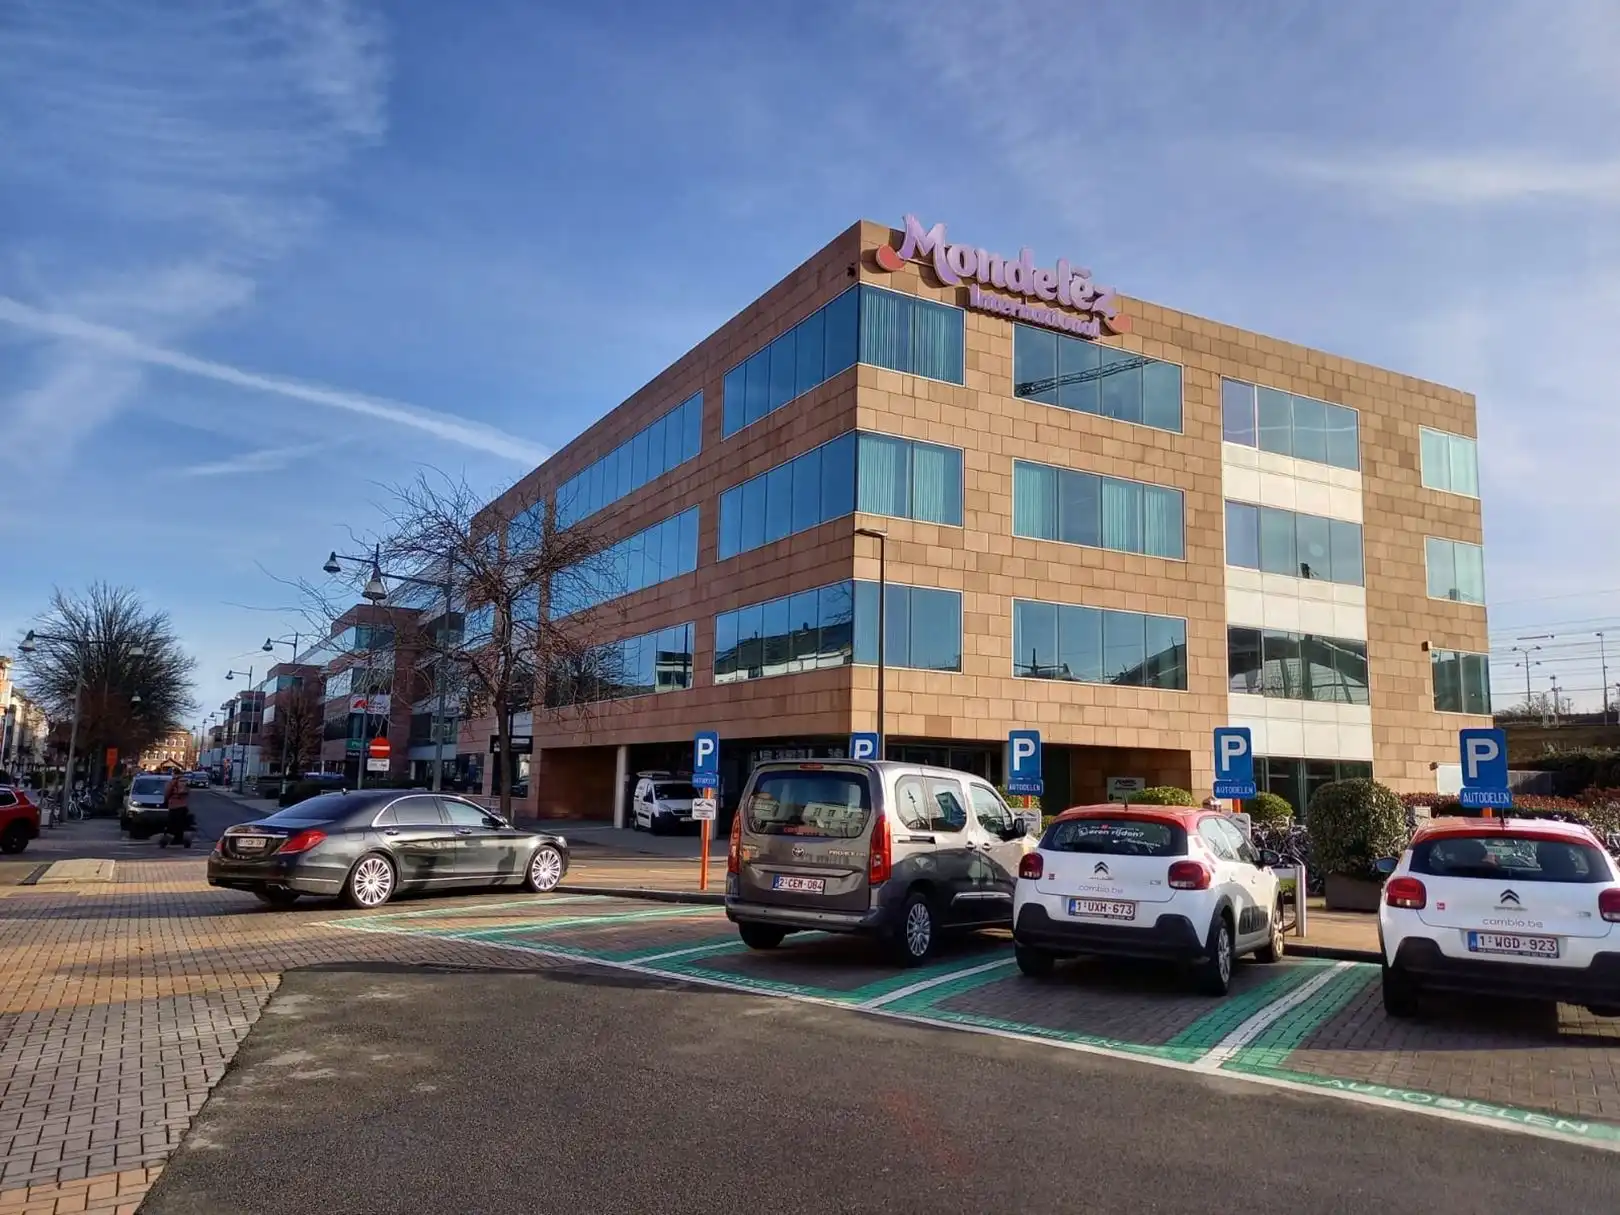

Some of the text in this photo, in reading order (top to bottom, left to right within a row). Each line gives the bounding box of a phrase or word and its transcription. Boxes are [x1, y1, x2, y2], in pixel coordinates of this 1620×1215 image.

[969, 283, 1101, 338] International
[697, 738, 714, 767] P
[853, 739, 873, 760] P
[1013, 738, 1036, 772] P
[1220, 734, 1247, 772] P
[1466, 738, 1499, 778] P
[1008, 783, 1041, 791] AUTODELEN
[1216, 786, 1254, 794] AUTODELEN
[1463, 791, 1510, 804] AUTODELEN
[1482, 917, 1544, 929] cambio.be
[1322, 1079, 1589, 1134] AUTODELEN
